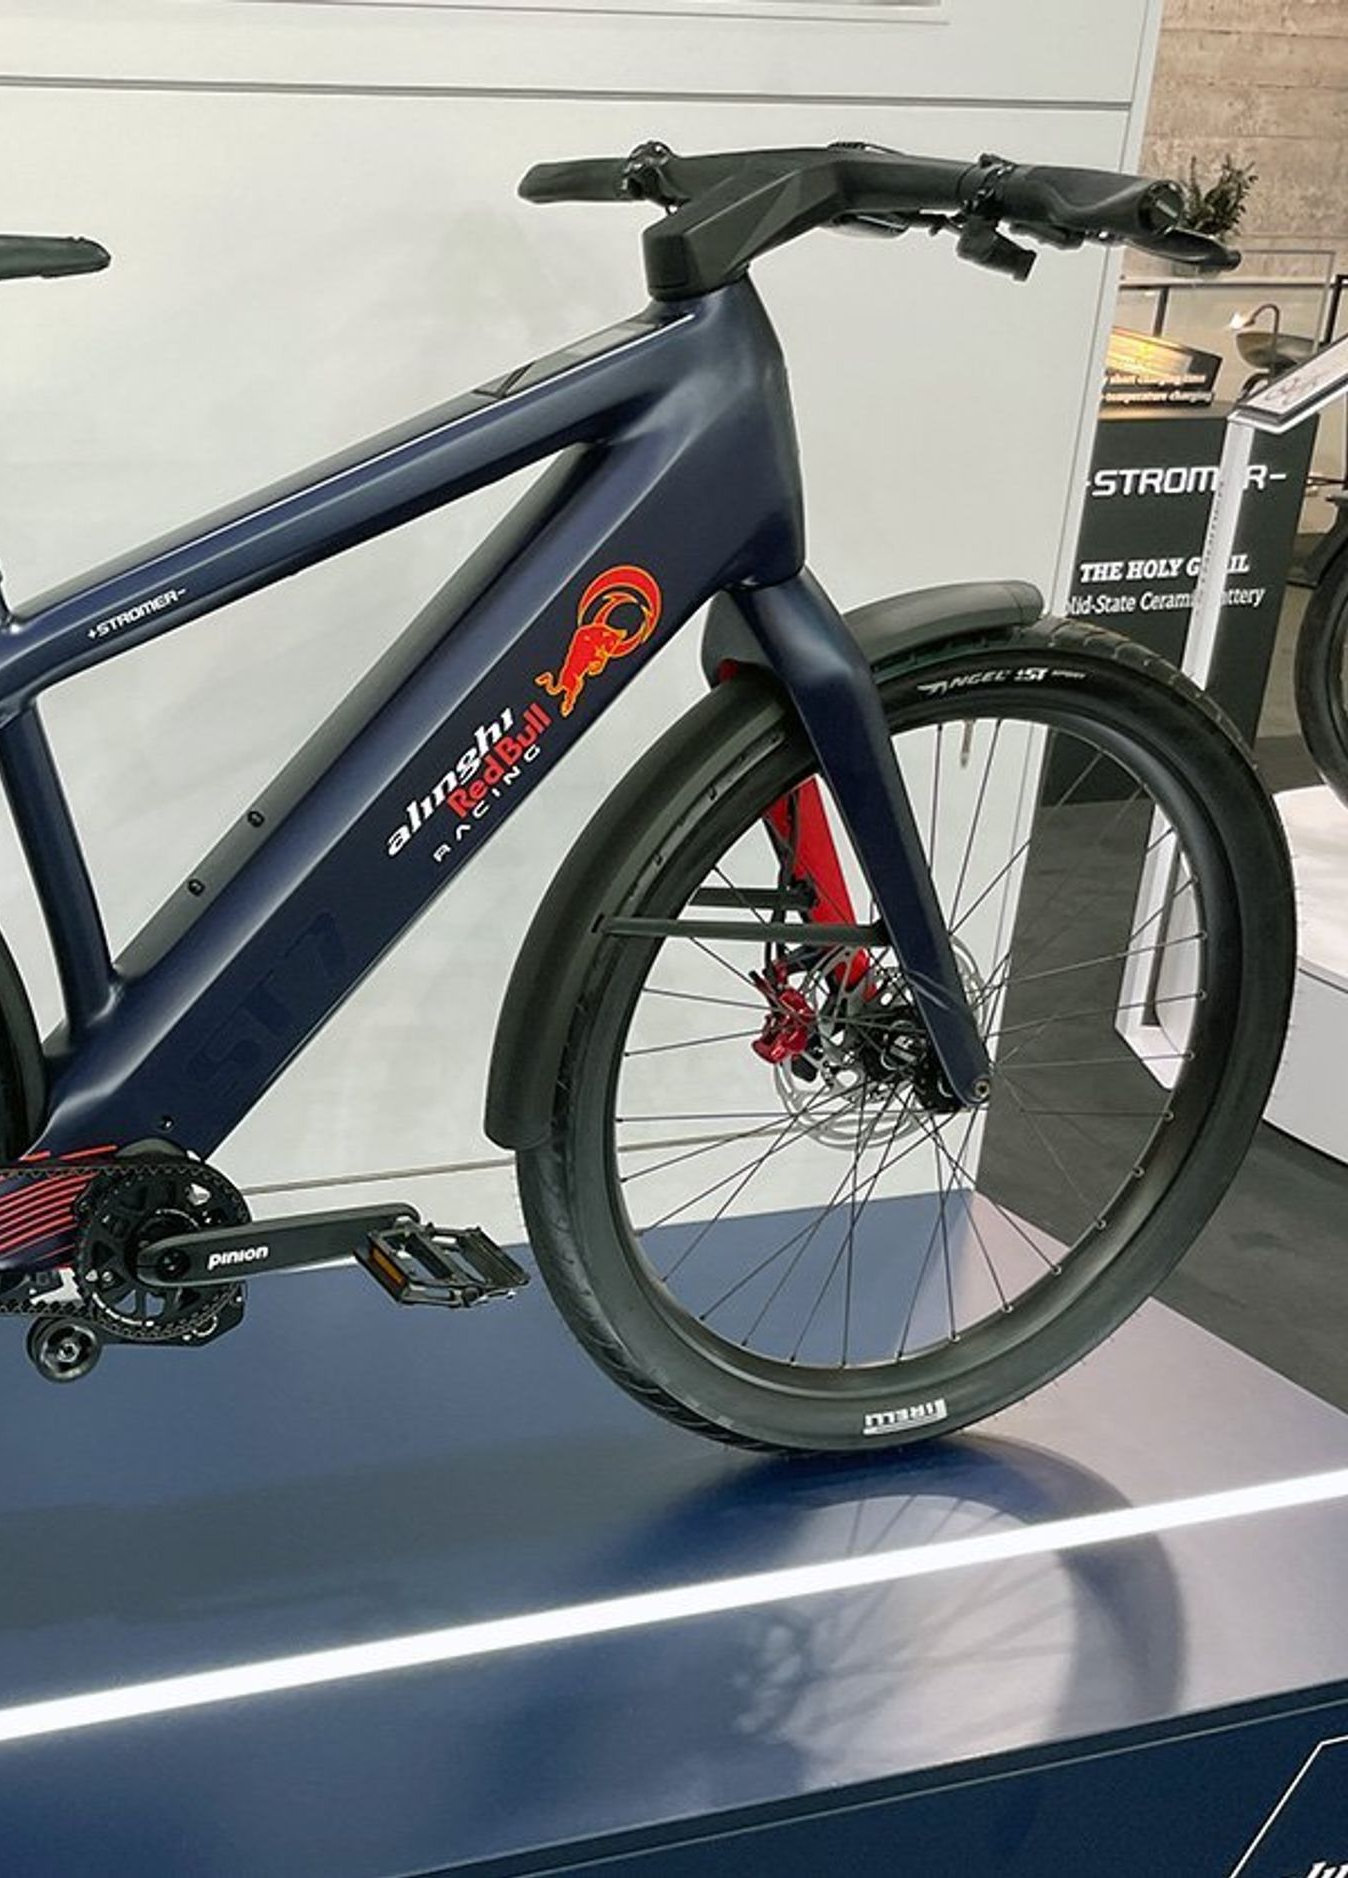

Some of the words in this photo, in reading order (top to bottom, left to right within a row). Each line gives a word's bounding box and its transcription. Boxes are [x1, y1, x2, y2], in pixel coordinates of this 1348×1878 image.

[1080, 561, 1125, 583] THE
[1126, 558, 1186, 580] HOLY
[1186, 554, 1251, 577] GIL
[433, 743, 542, 863] RACING
[206, 1246, 269, 1271] pinion
[863, 1398, 948, 1436] PIRELLI
